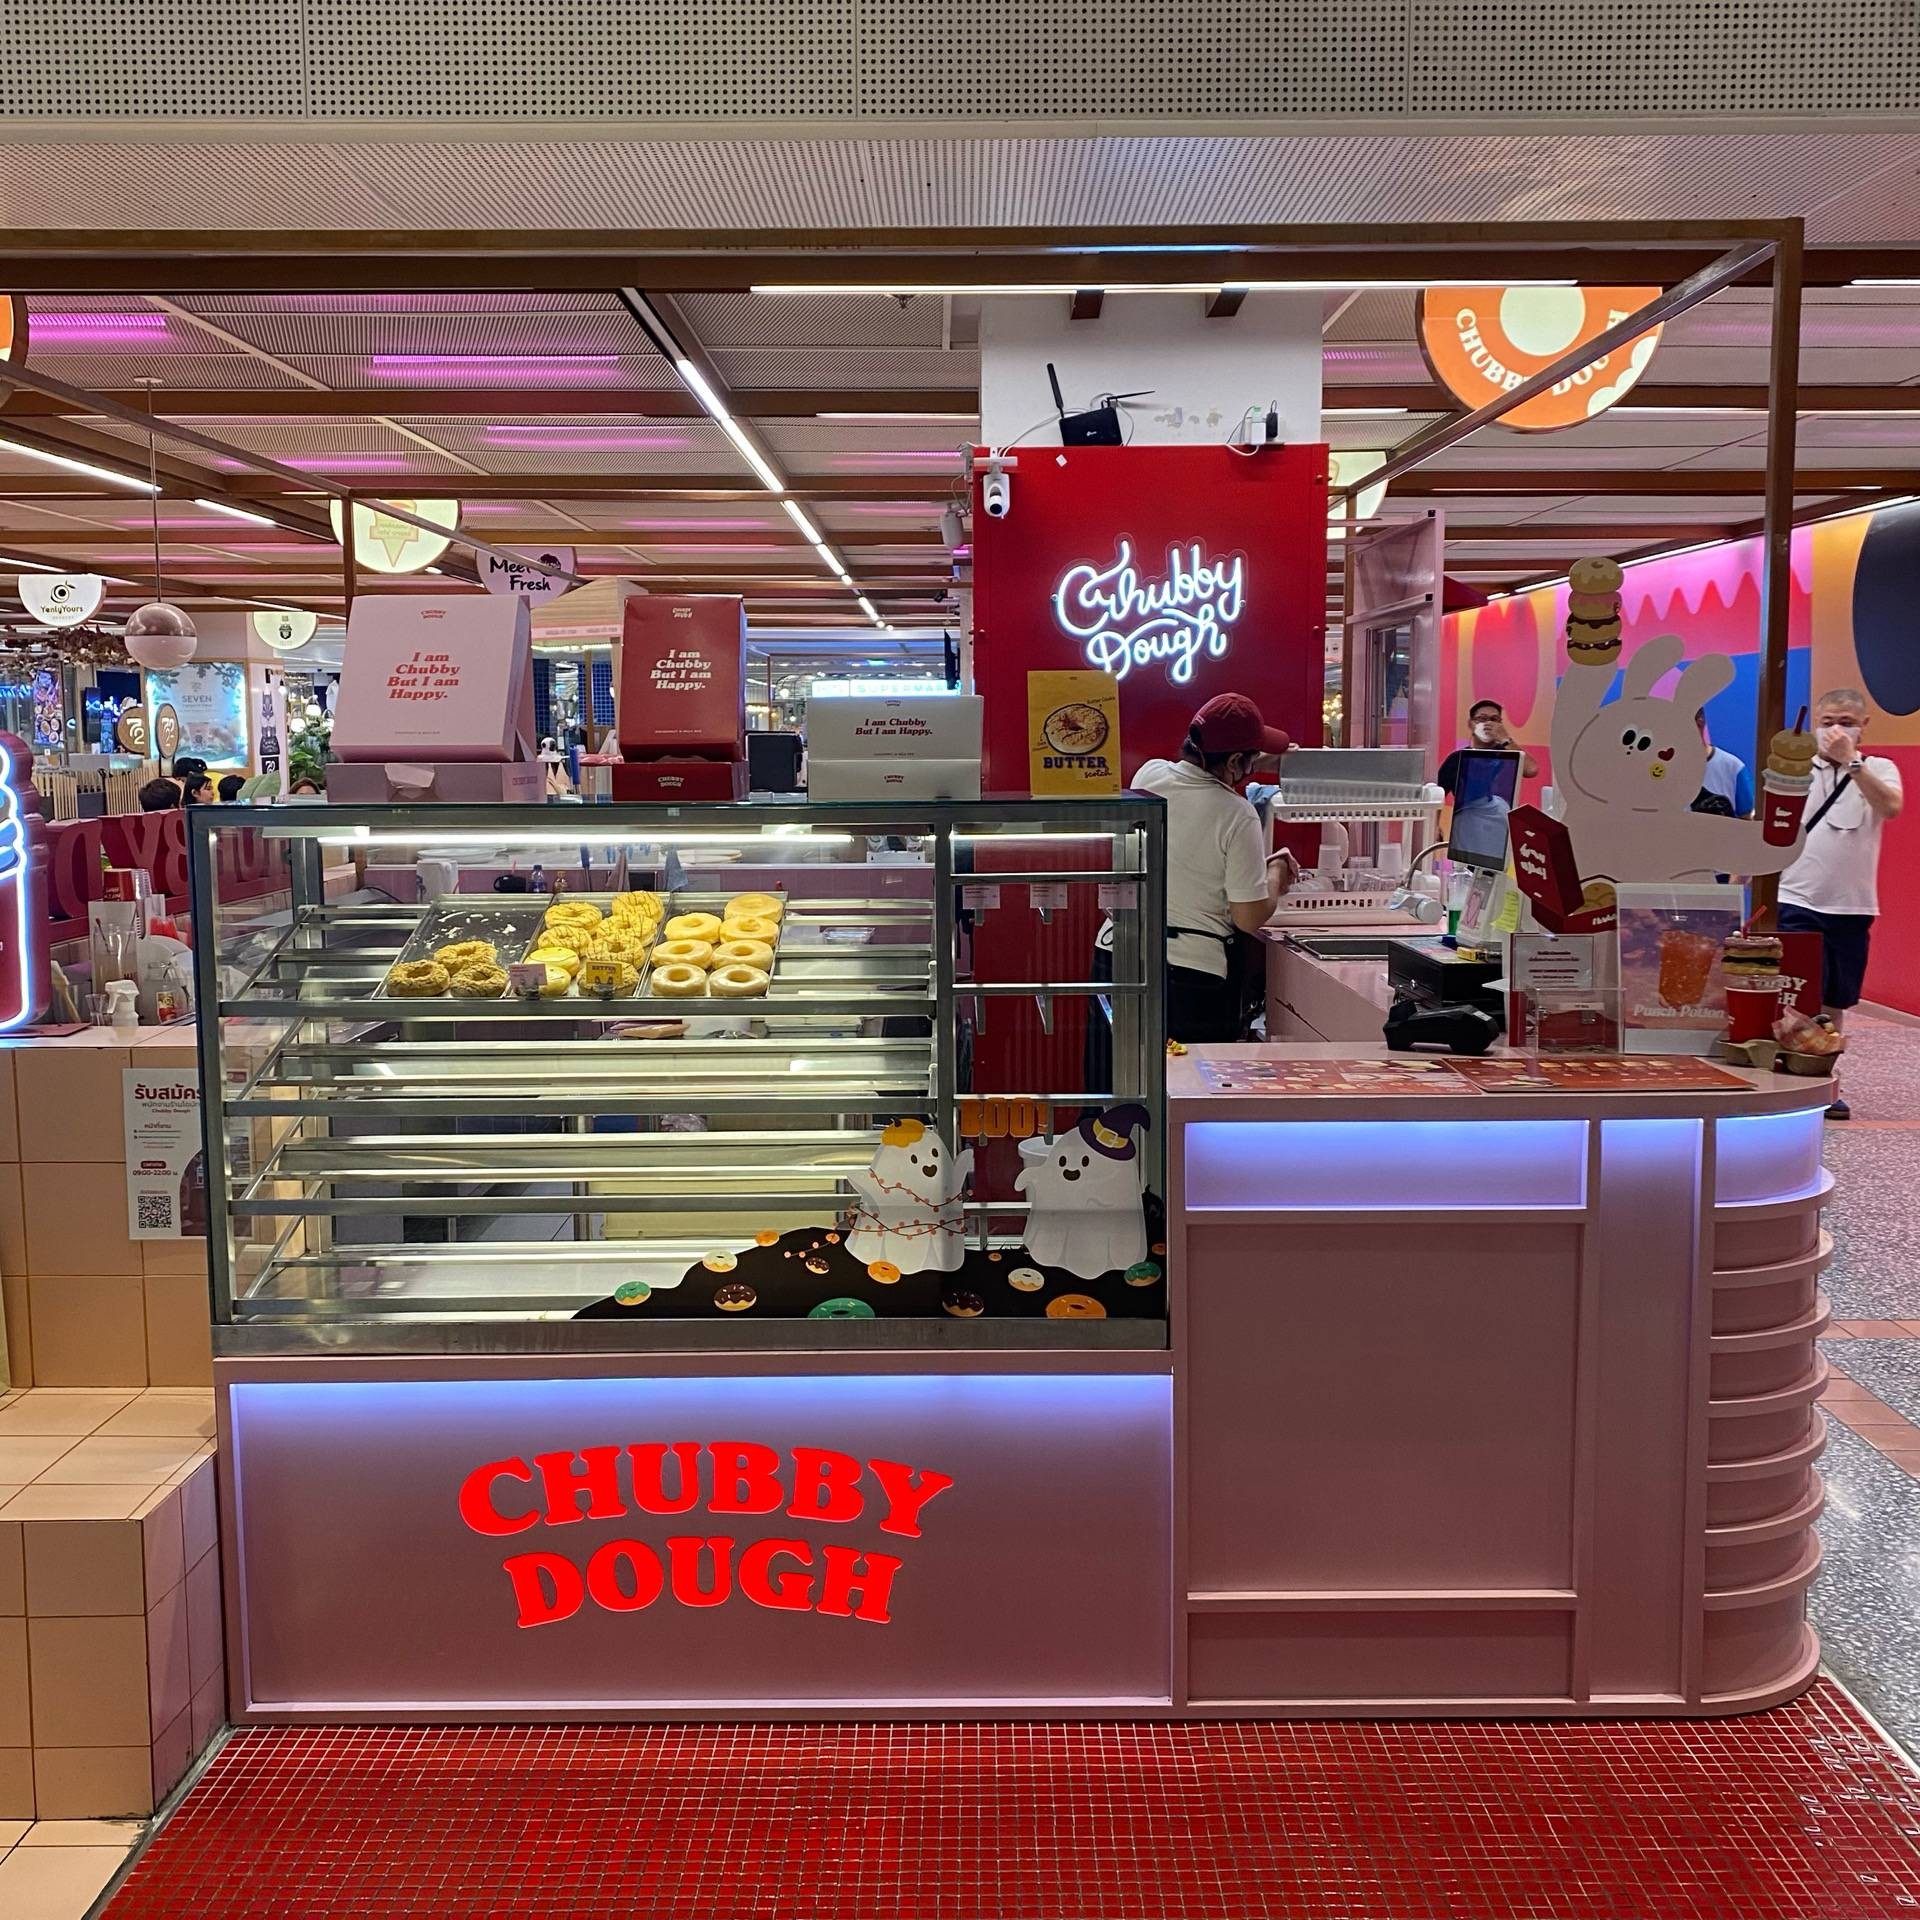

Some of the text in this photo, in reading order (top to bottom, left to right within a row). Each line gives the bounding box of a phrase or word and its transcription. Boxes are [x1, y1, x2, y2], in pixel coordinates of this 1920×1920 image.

[1456, 308, 1532, 391] CHUBB
[509, 575, 552, 591] Fresh
[1057, 541, 1242, 635] Chubby
[1087, 603, 1228, 682] Dough
[412, 652, 450, 662] I am
[668, 649, 701, 659] I am
[395, 664, 460, 676] Chubby
[655, 659, 712, 671] Chubby
[649, 669, 712, 679] But I am
[387, 676, 460, 687] But I am
[655, 679, 706, 691] Happy.
[181, 695, 213, 704] SEVEN
[389, 688, 449, 701] Happy.
[864, 718, 927, 728] I am Chubby
[855, 727, 874, 736] But
[875, 727, 880, 736] I
[899, 727, 934, 737] Happy.
[1043, 756, 1109, 769] BUTTER
[1084, 767, 1113, 779] scotch
[1633, 1003, 1726, 1018] Punch Potion
[458, 1442, 954, 1538] CHUBBY
[503, 1536, 904, 1628] DOUGH
